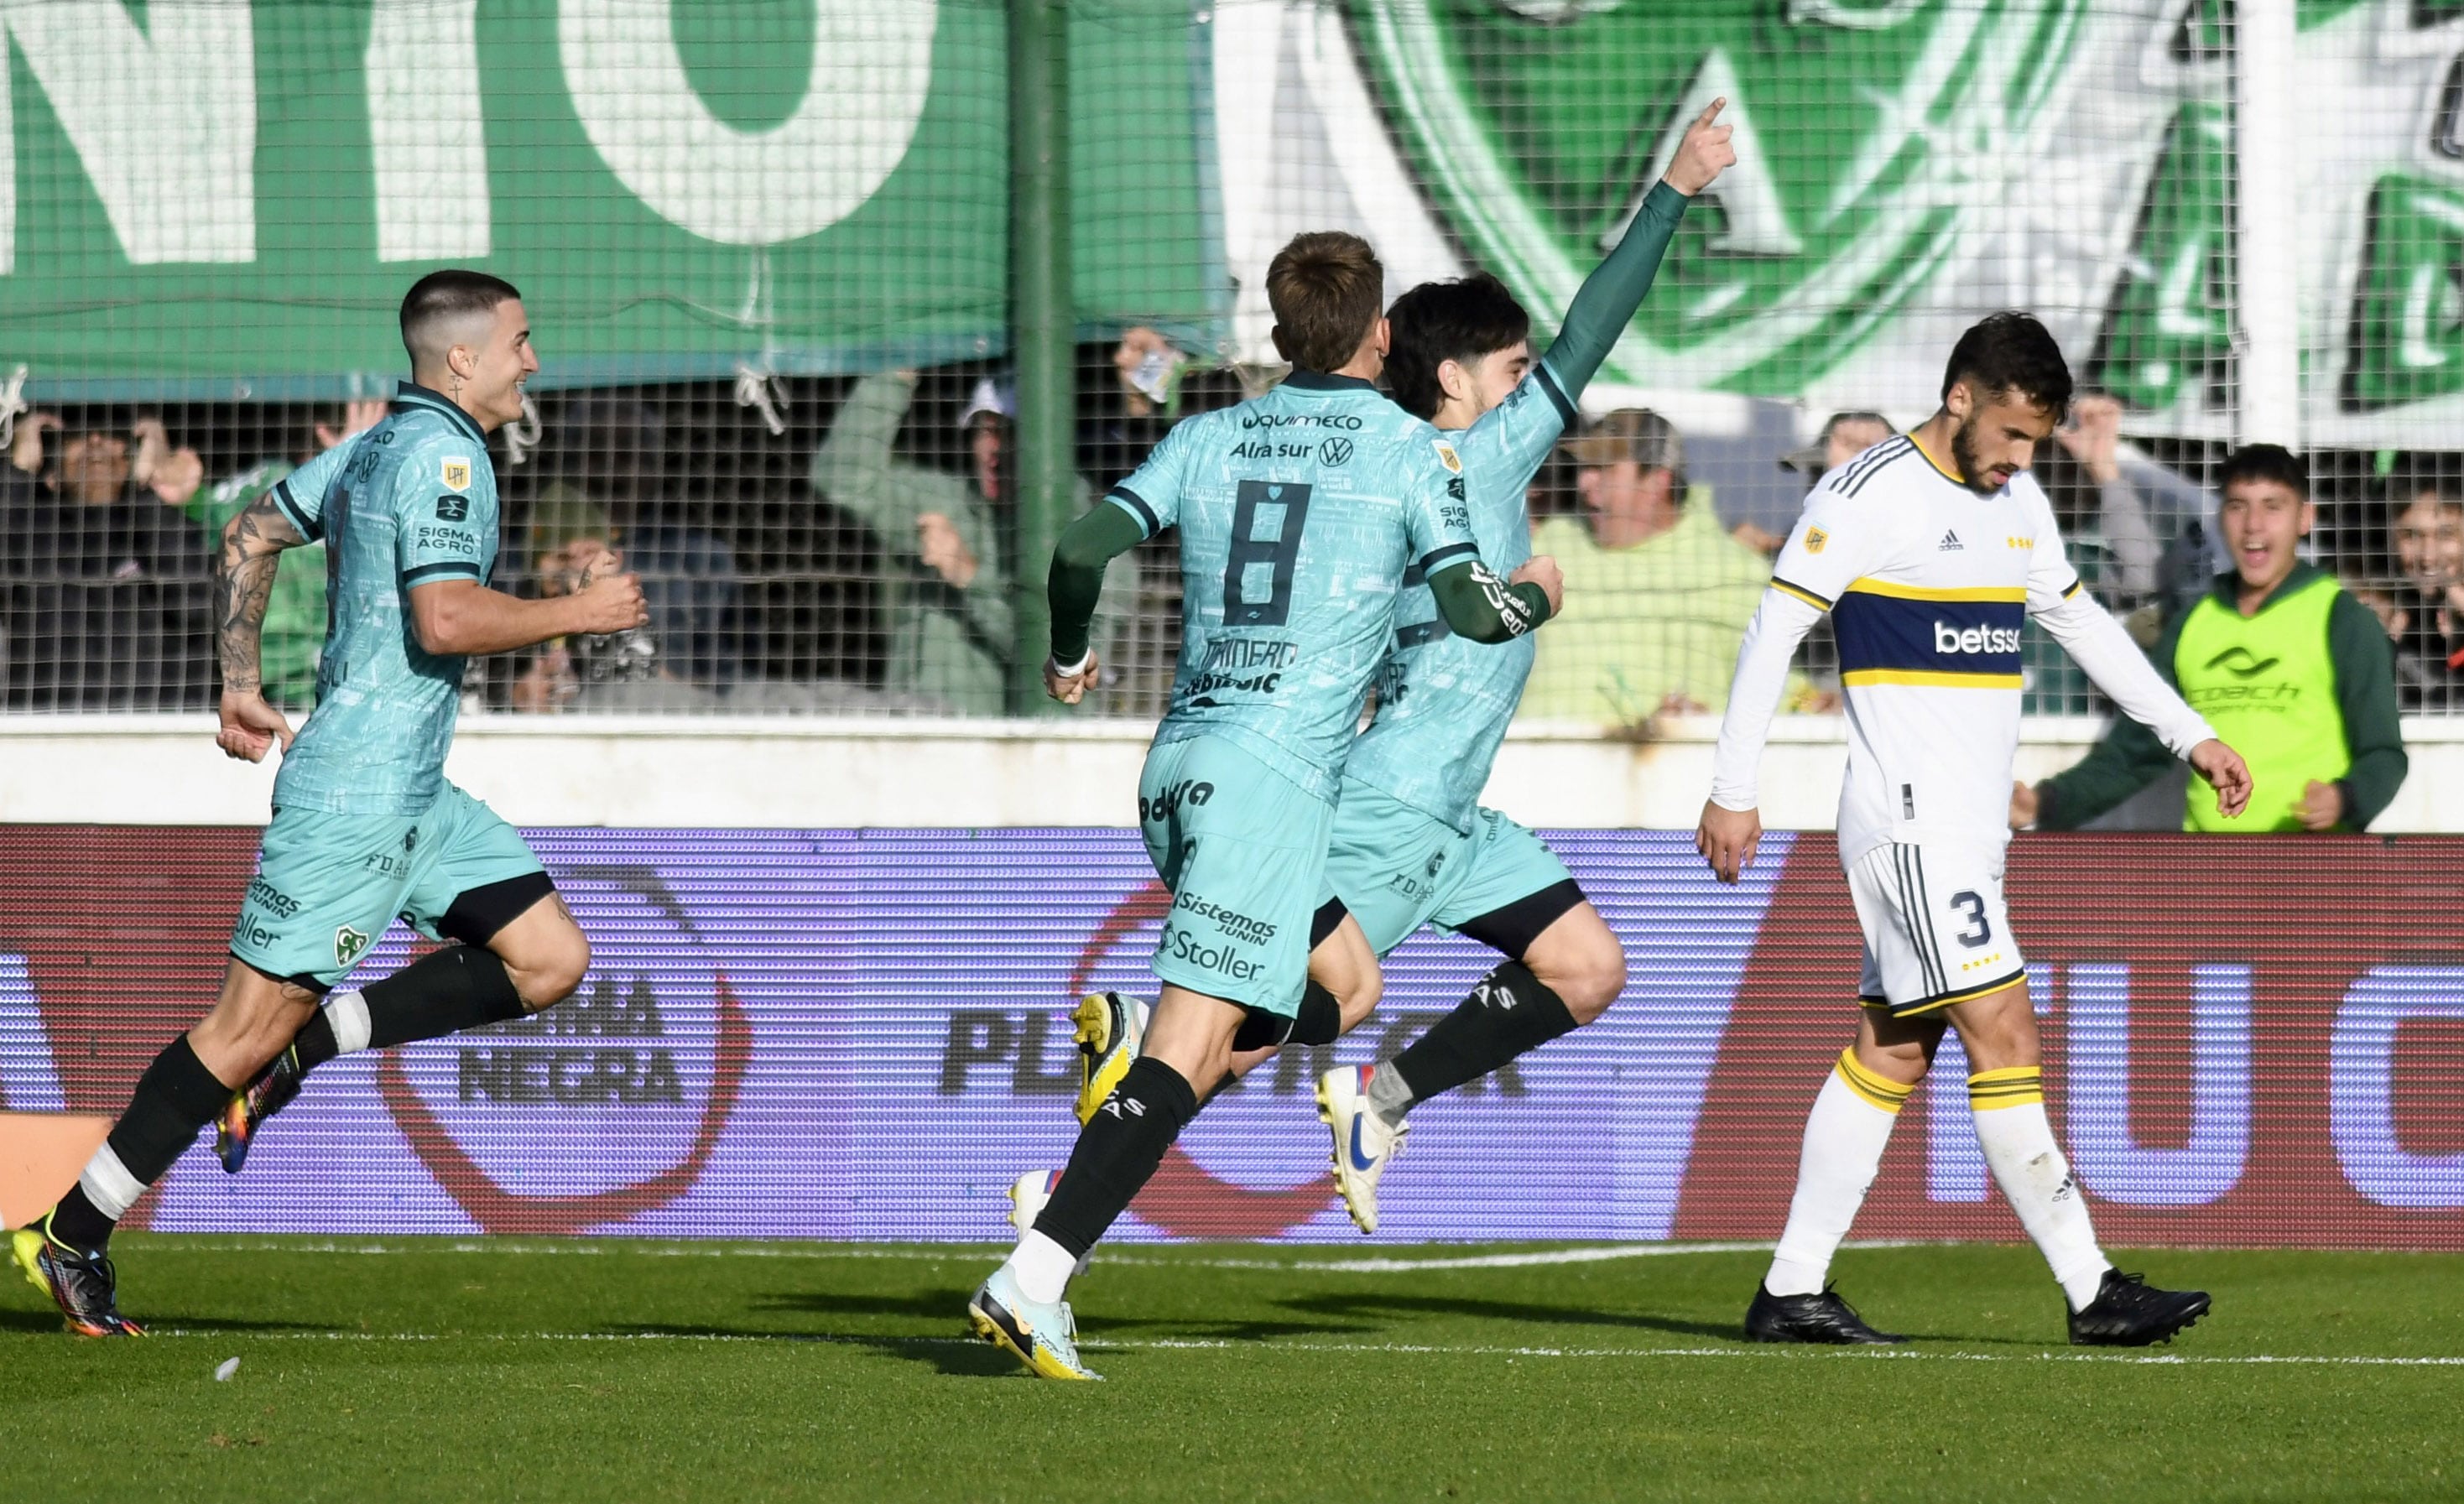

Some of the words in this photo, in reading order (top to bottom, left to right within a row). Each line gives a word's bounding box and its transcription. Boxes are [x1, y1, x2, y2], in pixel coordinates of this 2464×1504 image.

[1277, 443, 1313, 459] sur
[1440, 507, 1467, 518] SIG
[417, 539, 474, 555] AGRO
[419, 527, 476, 545] SIGMA
[1222, 480, 1313, 627] 8
[1180, 891, 1279, 939] Sistemas
[1949, 888, 1993, 950] 3
[1215, 924, 1268, 947] JUNIN
[1173, 930, 1266, 981] Stoller
[459, 1047, 682, 1102] NEGRA
